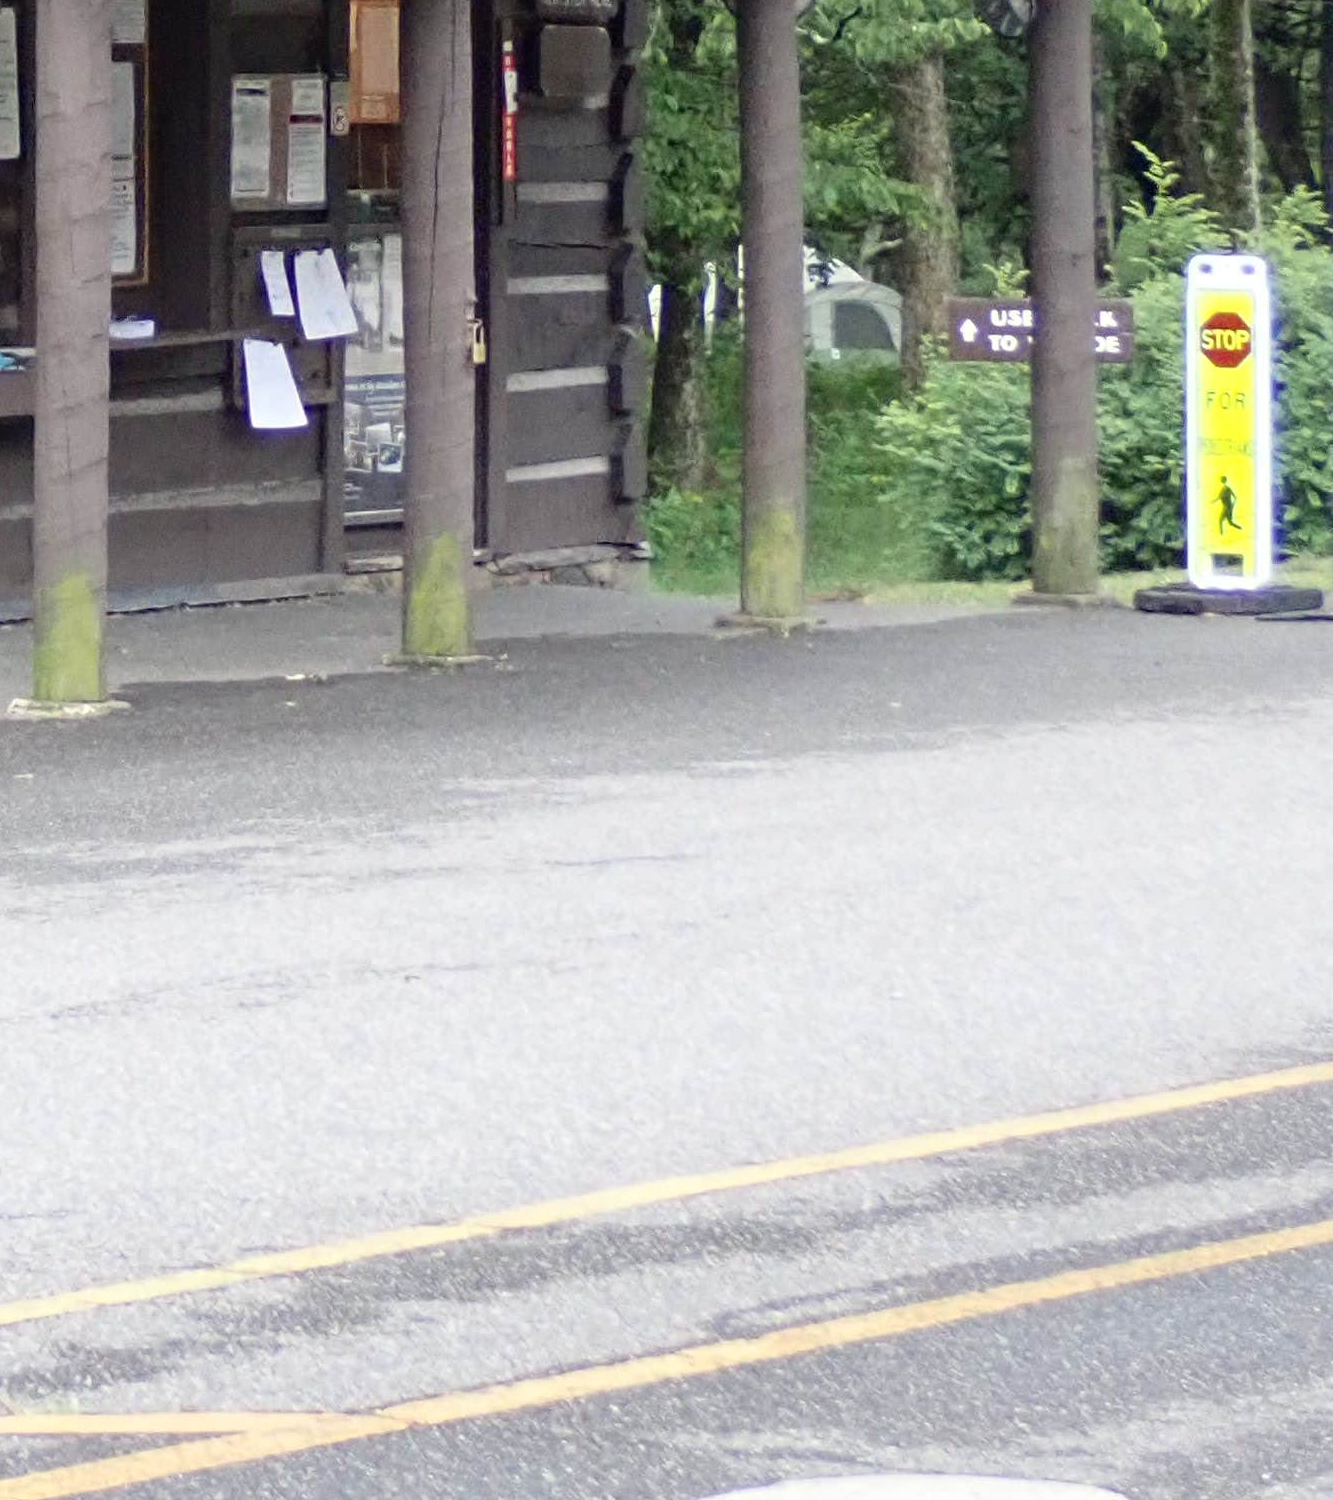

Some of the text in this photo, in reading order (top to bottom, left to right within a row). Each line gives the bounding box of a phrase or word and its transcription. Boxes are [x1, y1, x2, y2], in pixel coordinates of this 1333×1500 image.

[988, 334, 1019, 352] TO
[1201, 328, 1251, 350] STOP
[1206, 391, 1246, 411] FOR
